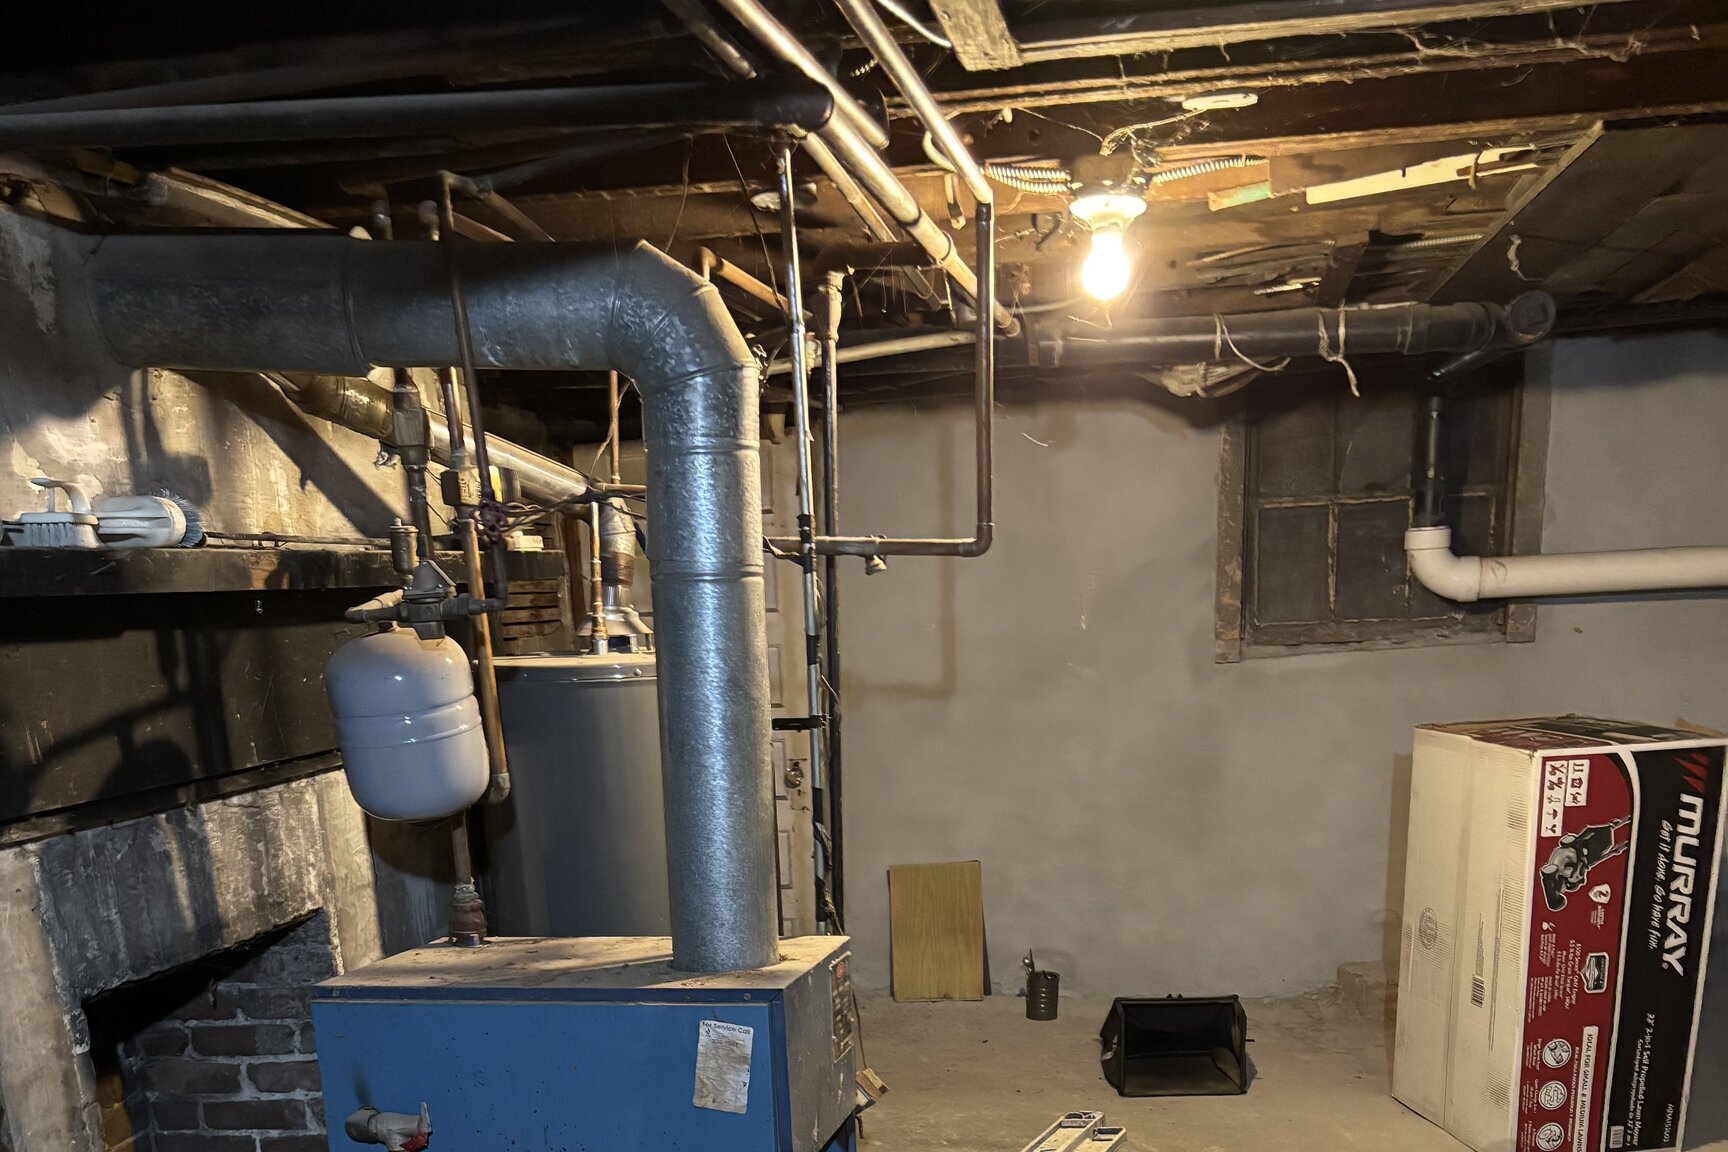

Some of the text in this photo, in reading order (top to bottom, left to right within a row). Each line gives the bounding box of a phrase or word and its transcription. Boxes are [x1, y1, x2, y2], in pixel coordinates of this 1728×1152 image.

[1660, 820, 1673, 842] Get
[1653, 885, 1666, 902] Go
[1662, 793, 1704, 976] MURRAY
[1651, 904, 1663, 927] have
[713, 1023, 736, 1031] Service
[1642, 1051, 1651, 1064] Self
[1582, 1070, 1590, 1091] SMALL
[1638, 1066, 1649, 1099] Propelled
[1578, 1100, 1586, 1128] MEDIUM
[1636, 1101, 1645, 1120] Lawn
[1632, 1121, 1642, 1146] Mower
